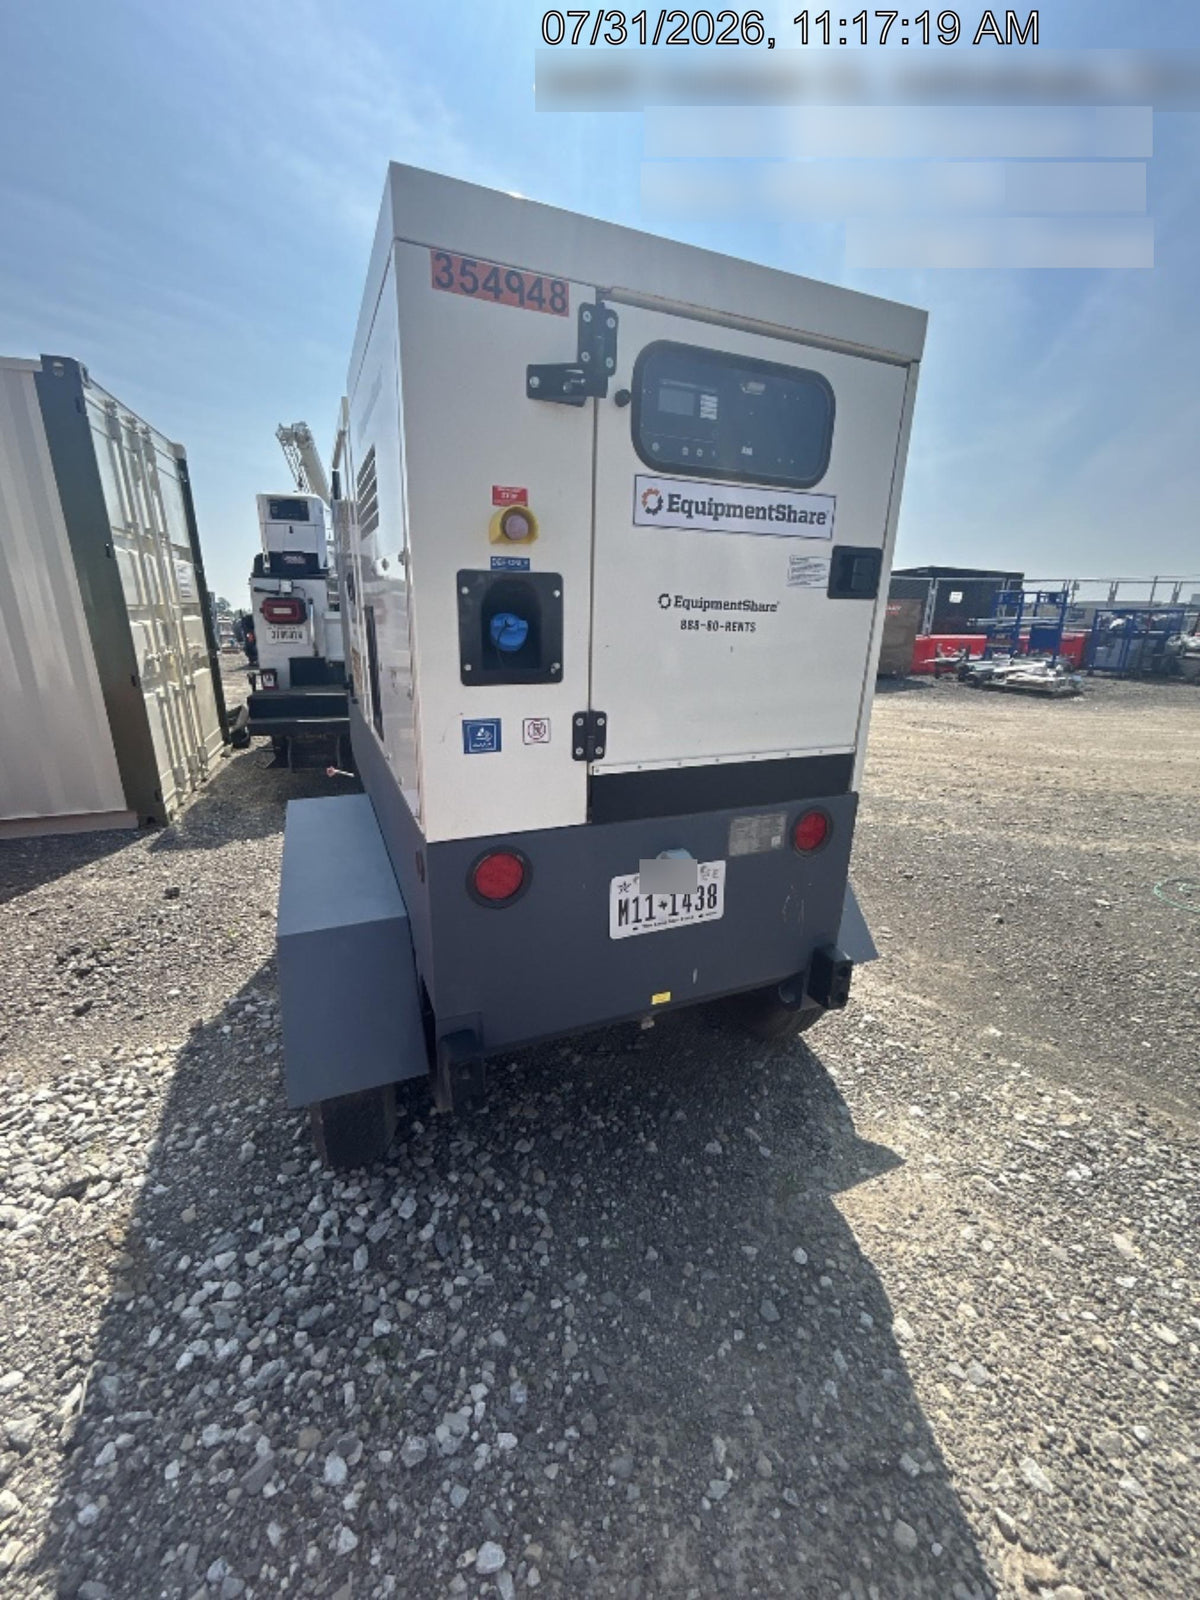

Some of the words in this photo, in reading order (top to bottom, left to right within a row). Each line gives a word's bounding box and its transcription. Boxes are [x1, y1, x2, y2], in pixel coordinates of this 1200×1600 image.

[434, 252, 568, 314] 354948
[667, 493, 827, 526] EquipmentShare
[673, 594, 777, 613] EquipmentShare
